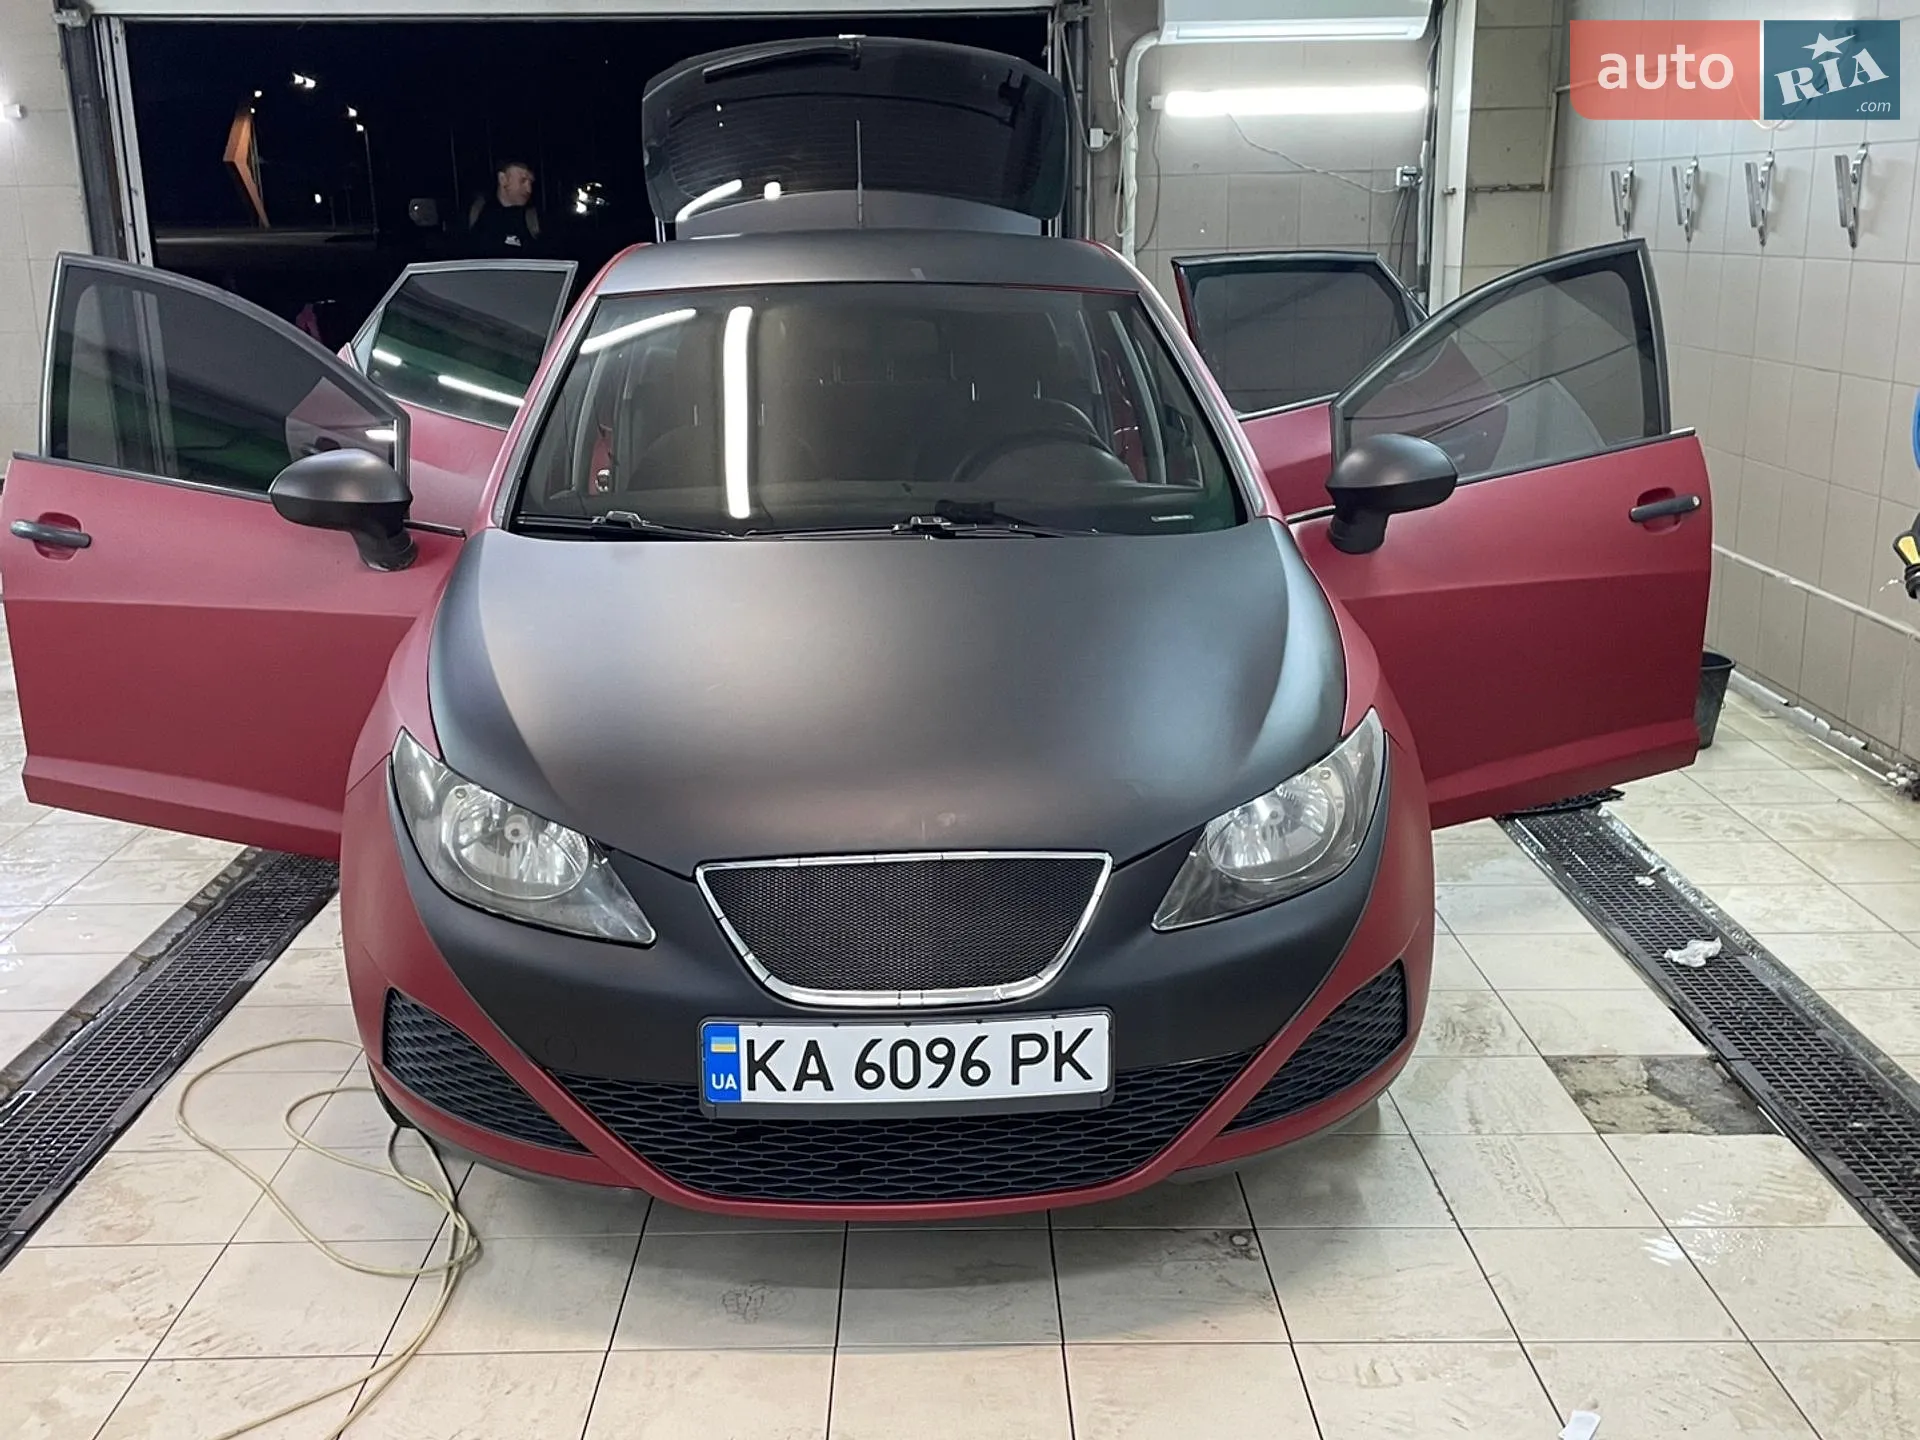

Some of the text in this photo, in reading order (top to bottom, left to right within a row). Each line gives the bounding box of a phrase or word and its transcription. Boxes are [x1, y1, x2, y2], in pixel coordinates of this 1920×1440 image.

[746, 1028, 1093, 1092] KA 6096 PK
[711, 1073, 738, 1090] UA
